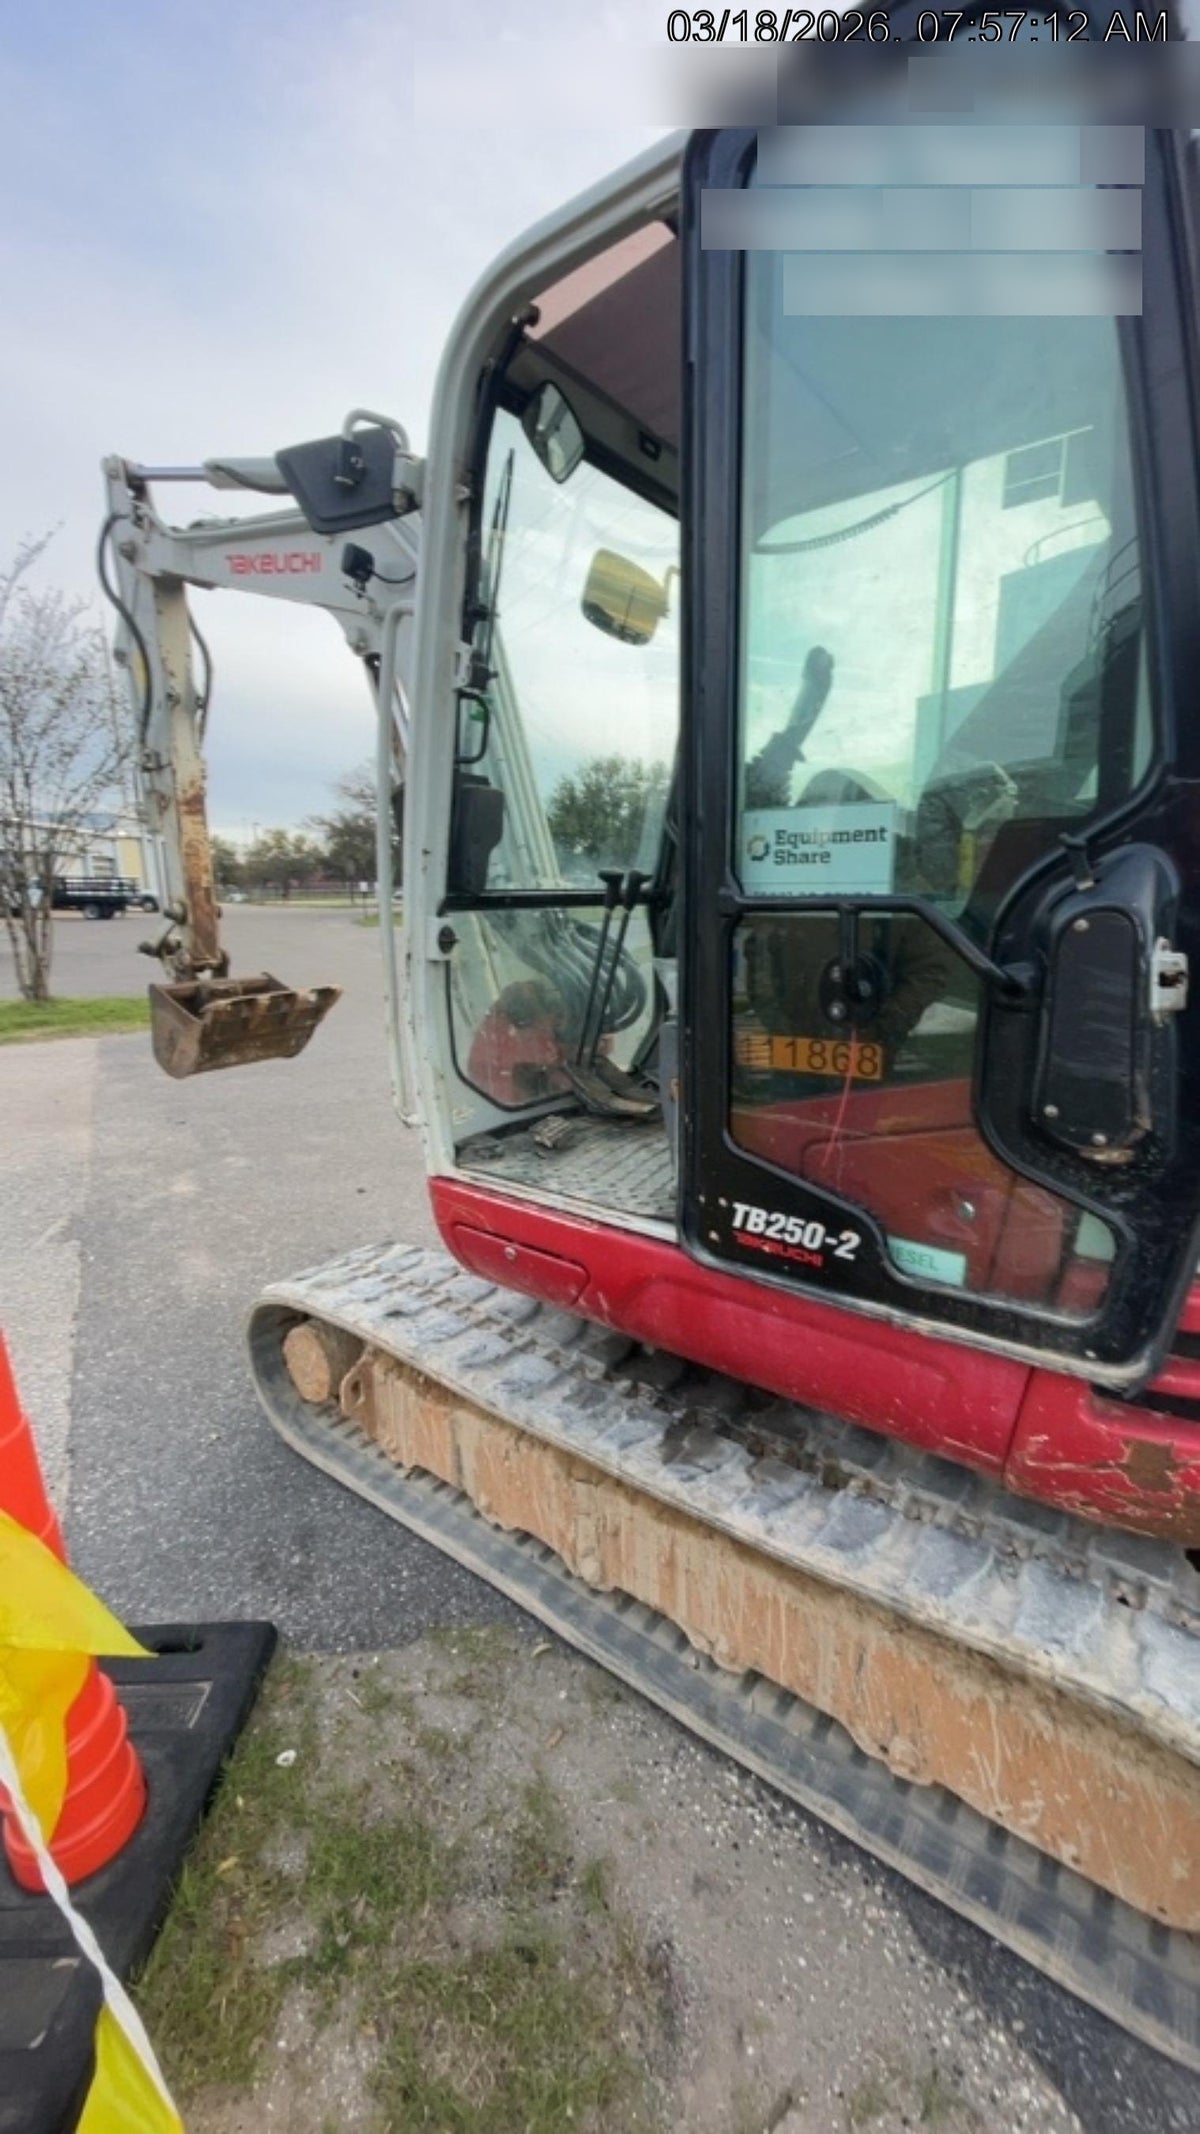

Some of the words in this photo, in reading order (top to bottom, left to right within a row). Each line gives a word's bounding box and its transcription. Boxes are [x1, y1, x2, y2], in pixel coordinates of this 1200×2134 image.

[774, 826, 888, 849] Equipment
[774, 849, 831, 866] Share
[732, 1202, 861, 1260] TB250-2
